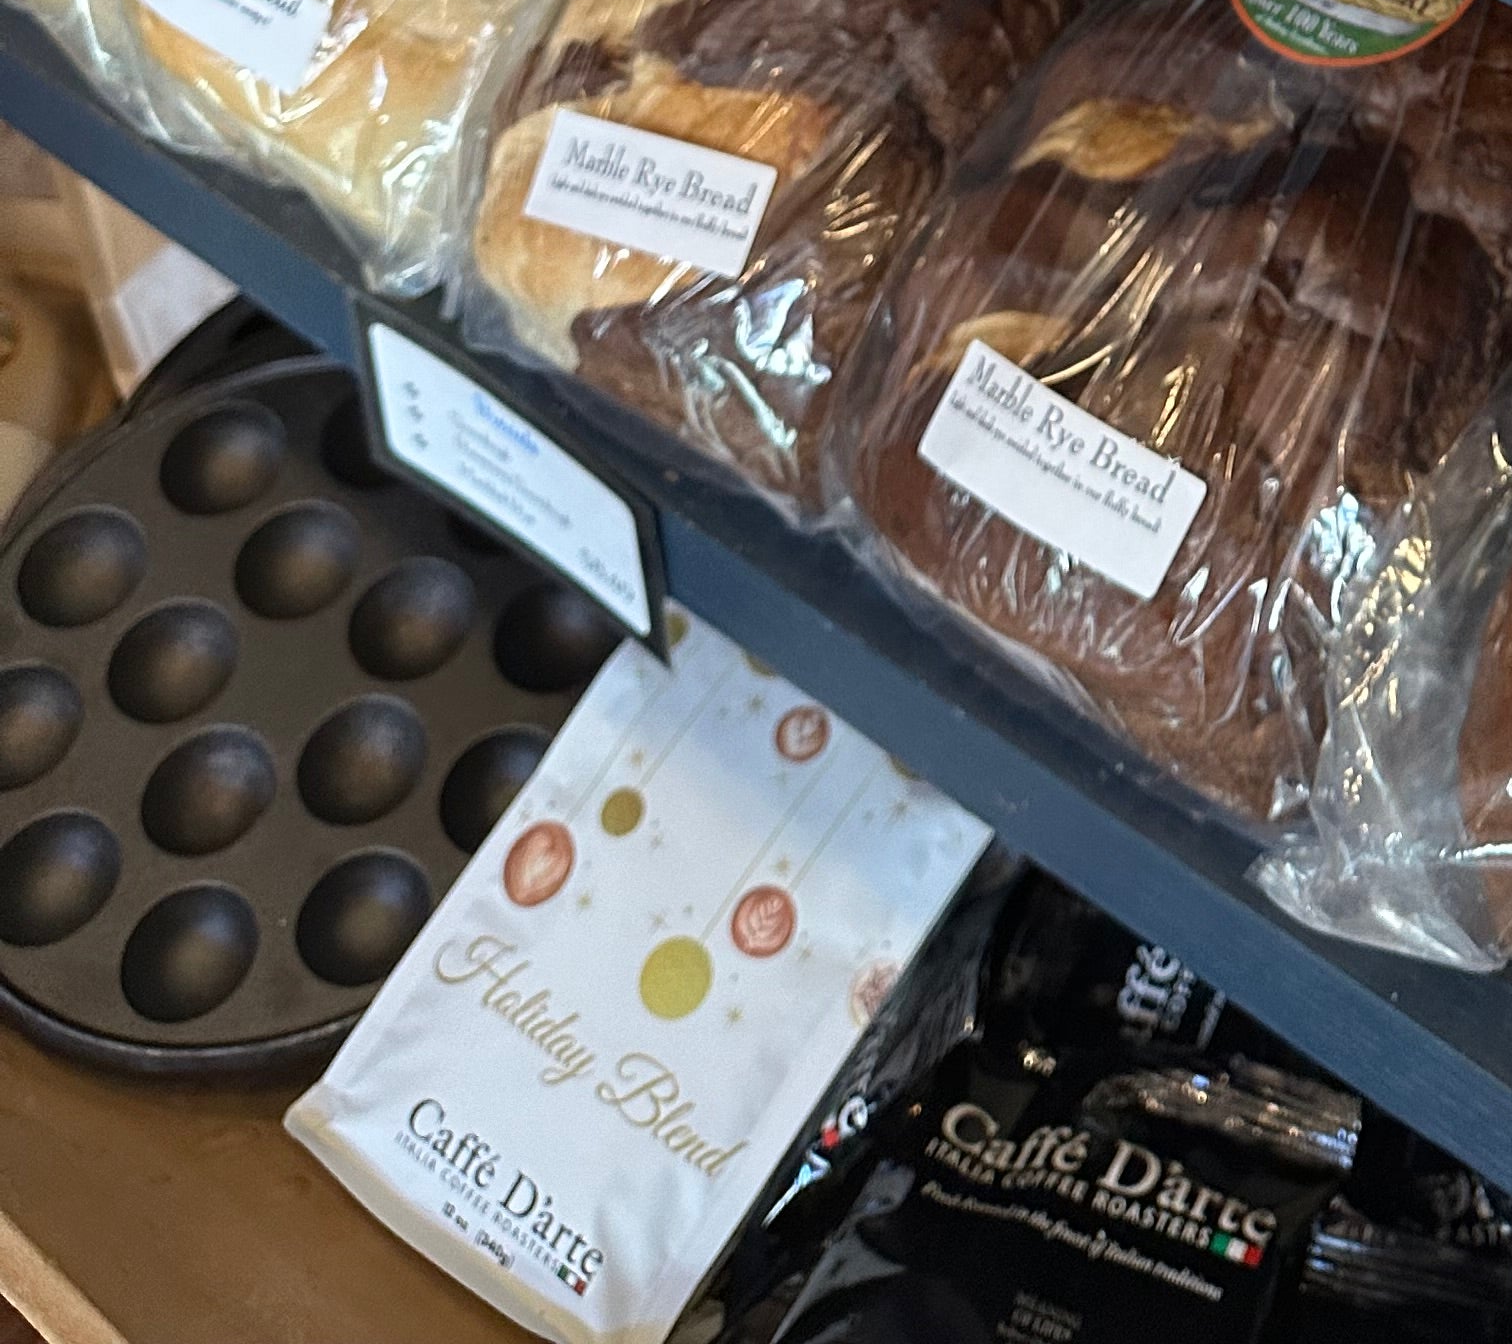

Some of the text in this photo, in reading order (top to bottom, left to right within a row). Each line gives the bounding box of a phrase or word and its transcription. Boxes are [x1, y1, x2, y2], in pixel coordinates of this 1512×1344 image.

[632, 157, 677, 196] Rye
[679, 168, 758, 213] Bread
[966, 354, 1034, 423] Marble
[1037, 404, 1085, 456] Rye
[1089, 434, 1177, 505] Bread
[432, 934, 598, 1086] Holiday
[596, 1053, 749, 1180] Blend
[409, 1099, 502, 1188] Caffé
[941, 1102, 1091, 1172] Caffé
